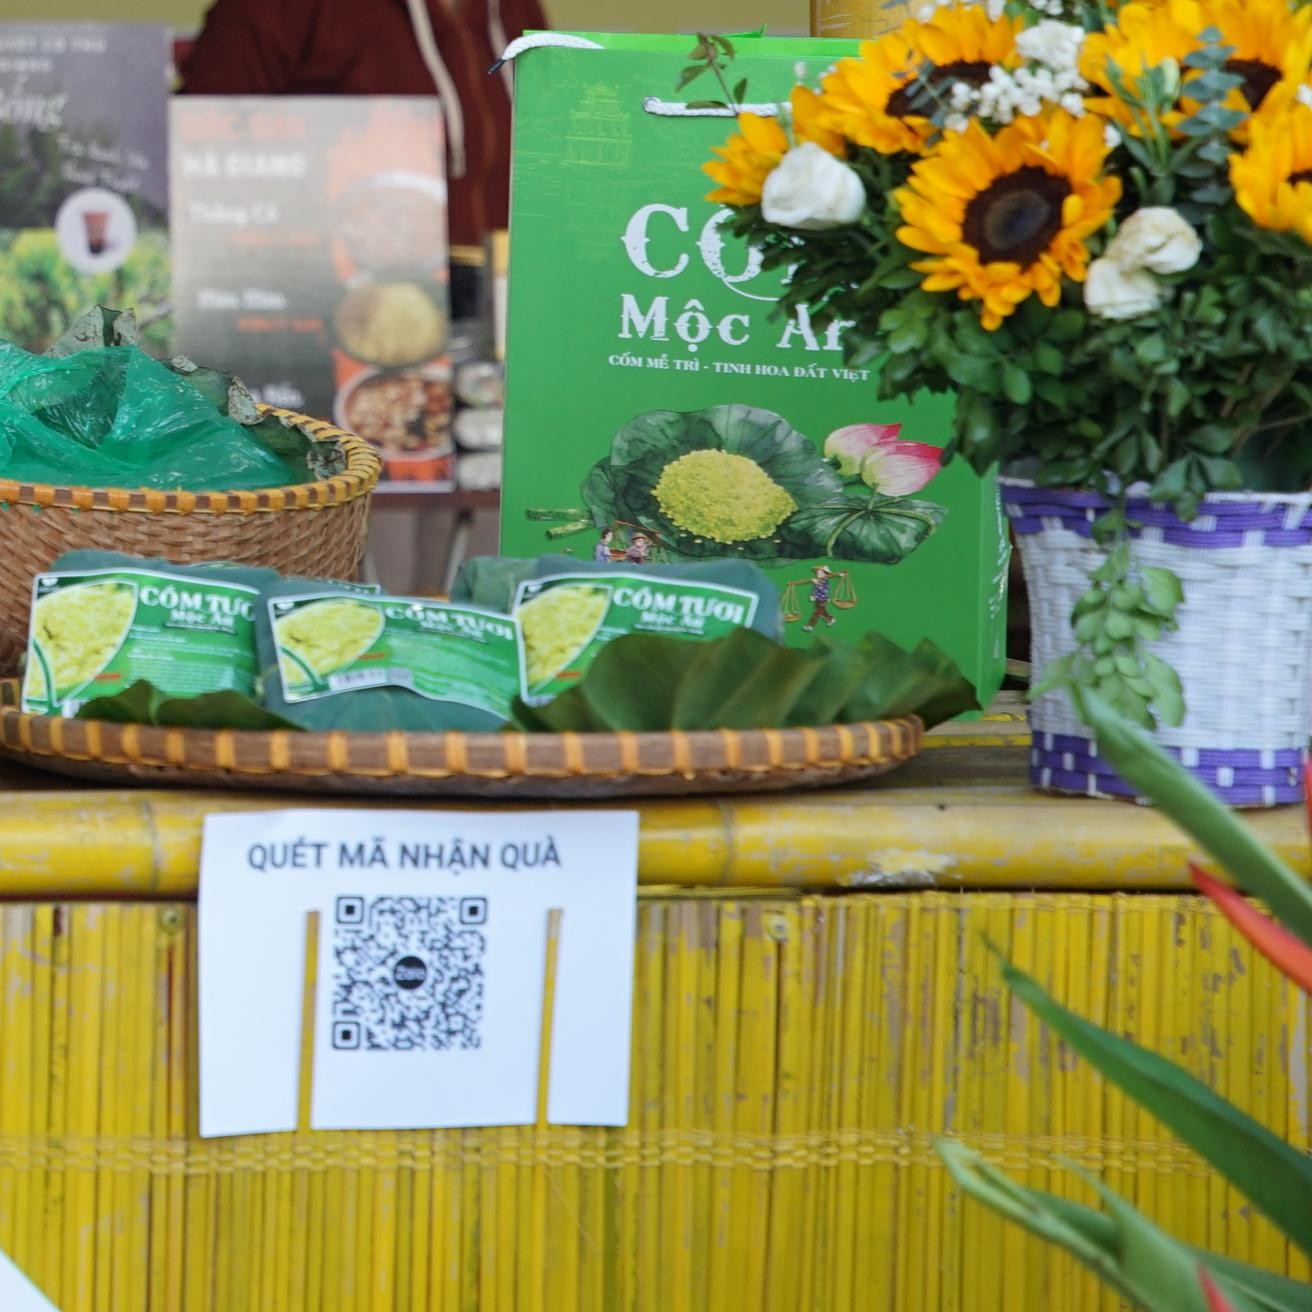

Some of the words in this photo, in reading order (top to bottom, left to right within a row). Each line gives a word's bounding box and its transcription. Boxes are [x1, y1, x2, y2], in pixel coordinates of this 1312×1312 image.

[618, 293, 750, 352] Mộc
[608, 352, 643, 368] CỐM
[646, 353, 670, 369] MỄ
[673, 358, 700, 372] TRÌ
[712, 362, 752, 375] TINH
[755, 364, 791, 377] HOA
[794, 363, 828, 379] ĐẤT
[832, 368, 871, 383] VIỆT
[140, 585, 203, 610] CỐM
[613, 587, 676, 612] CỐM
[248, 837, 329, 872] QUÉT
[338, 837, 389, 869] MÃ
[399, 840, 491, 876] NHẬN
[500, 835, 562, 870] QUÀ
